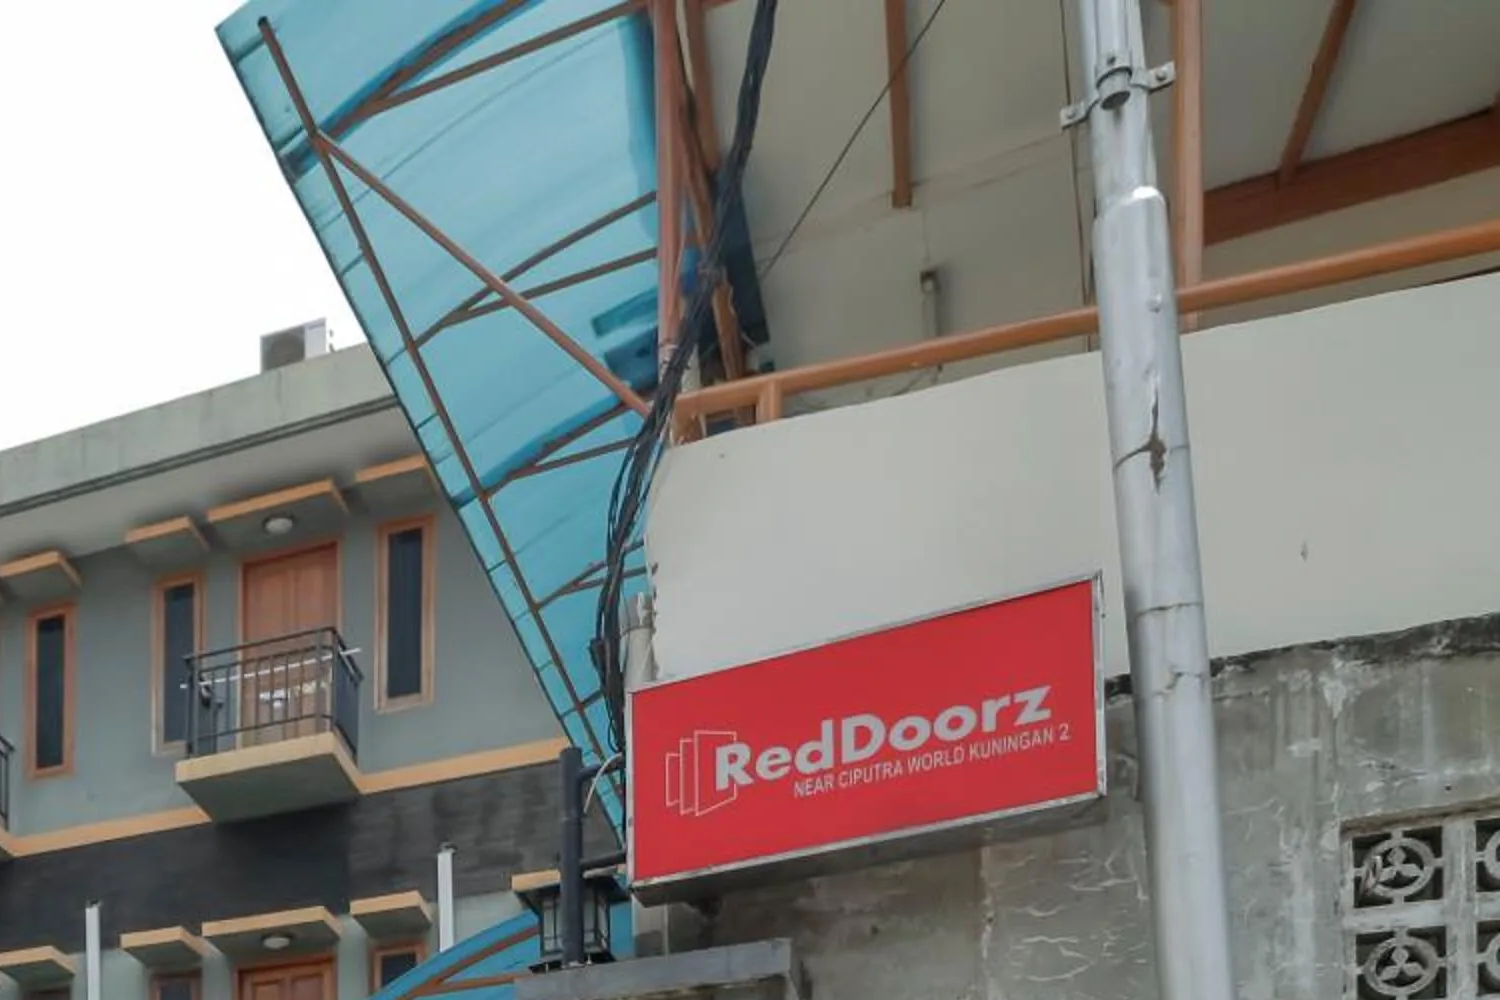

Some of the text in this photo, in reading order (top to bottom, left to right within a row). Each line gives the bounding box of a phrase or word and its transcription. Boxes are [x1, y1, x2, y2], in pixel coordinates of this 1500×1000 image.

[715, 685, 1052, 790] RedDoorz
[794, 722, 1071, 798] NEAR CIPUTRA WORLD KUNINGAN 2
